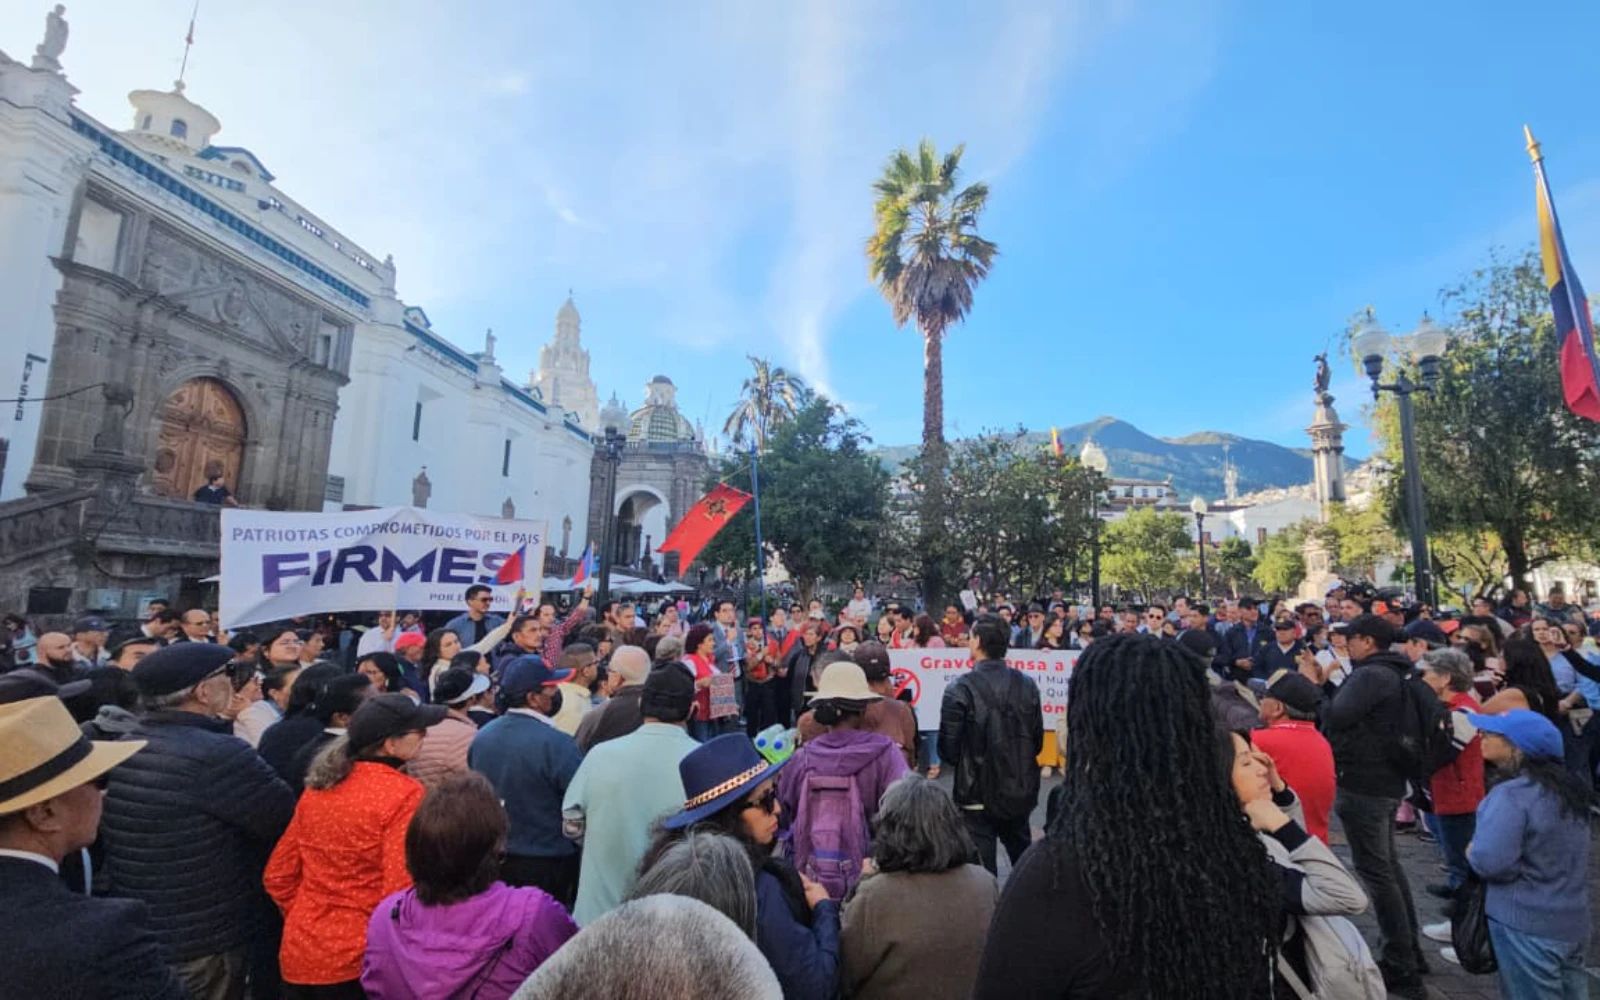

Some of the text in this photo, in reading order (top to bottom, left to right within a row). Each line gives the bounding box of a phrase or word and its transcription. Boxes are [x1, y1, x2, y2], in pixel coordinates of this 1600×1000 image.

[232, 521, 540, 544] PATRIOTAS COMPROMETIDOS POR EL PAIS
[262, 545, 514, 593] FIRMES
[429, 592, 451, 601] POR
[1055, 661, 1064, 672] a
